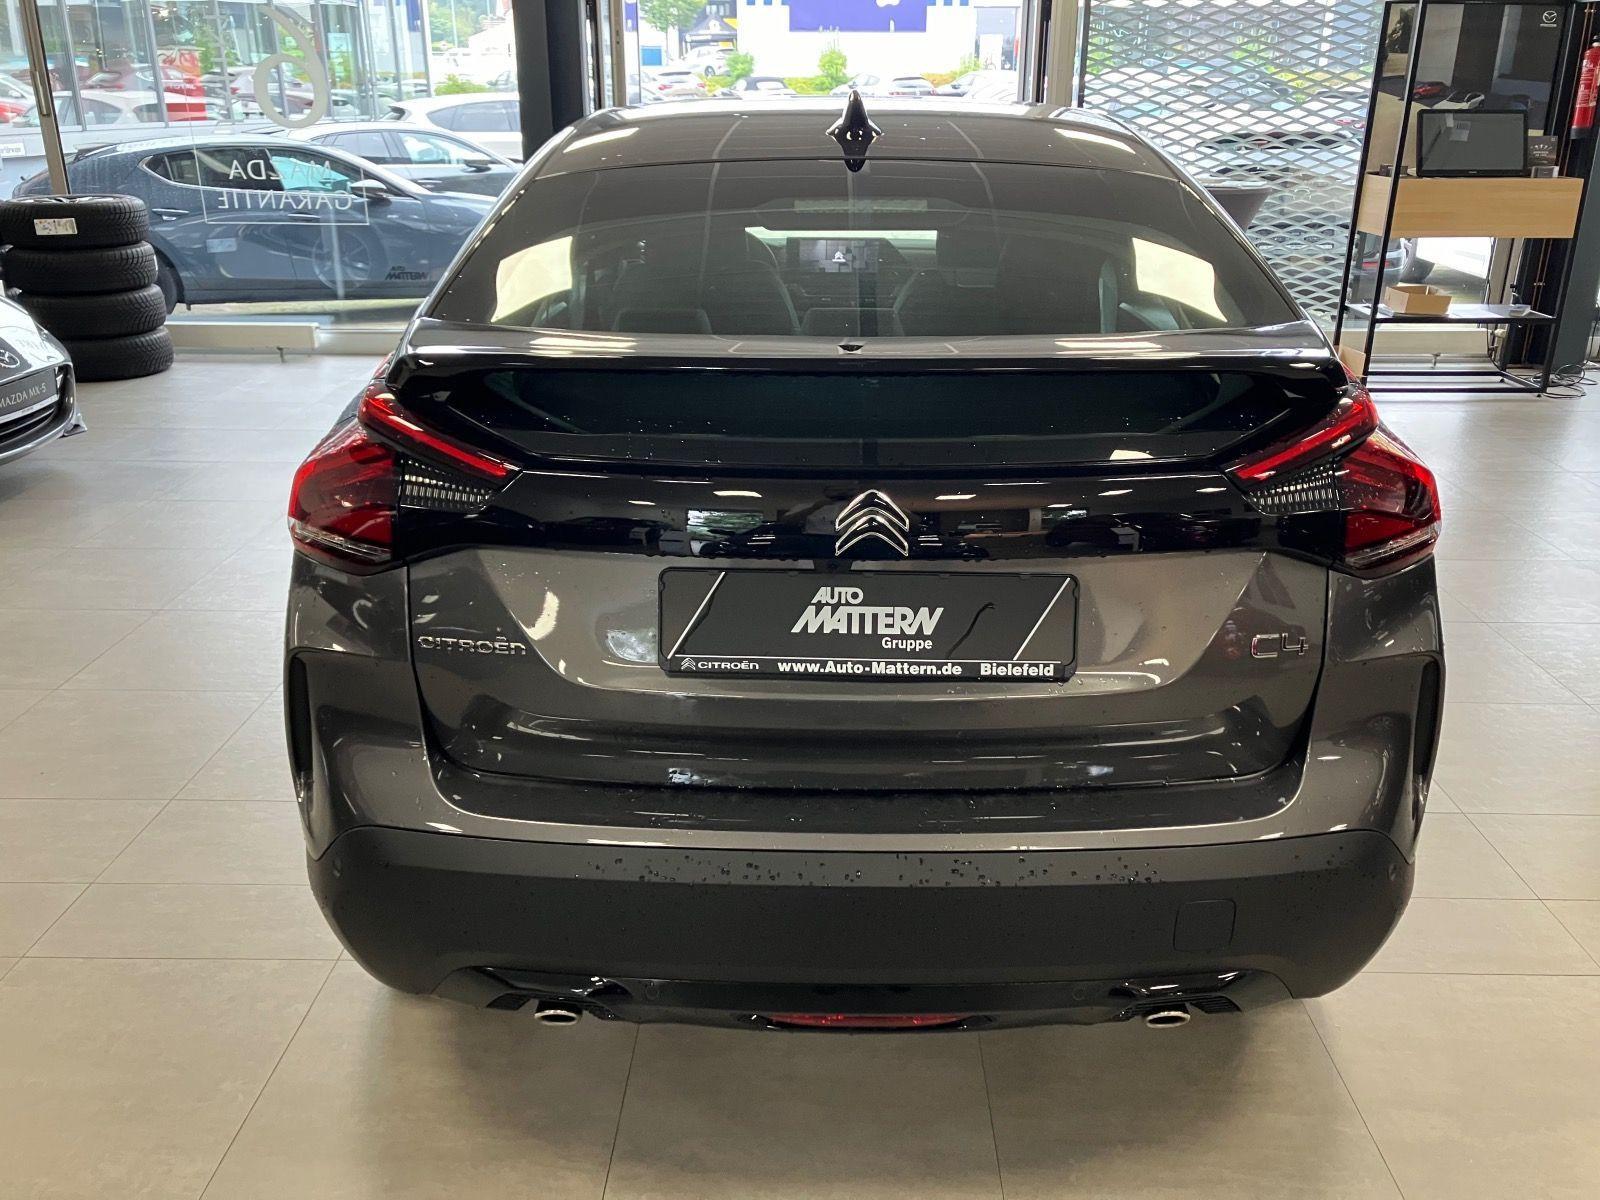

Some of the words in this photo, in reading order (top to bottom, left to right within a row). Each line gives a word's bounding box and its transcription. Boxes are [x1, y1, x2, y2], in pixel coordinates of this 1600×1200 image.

[29, 382, 46, 398] MX-5
[811, 586, 864, 604] AUTO
[790, 605, 945, 636] MATTERN
[881, 636, 933, 652] Gruppe
[1251, 632, 1309, 659] C4
[777, 660, 963, 677] www.Auto-Mattern.de
[980, 663, 1055, 677] Bielefeld
